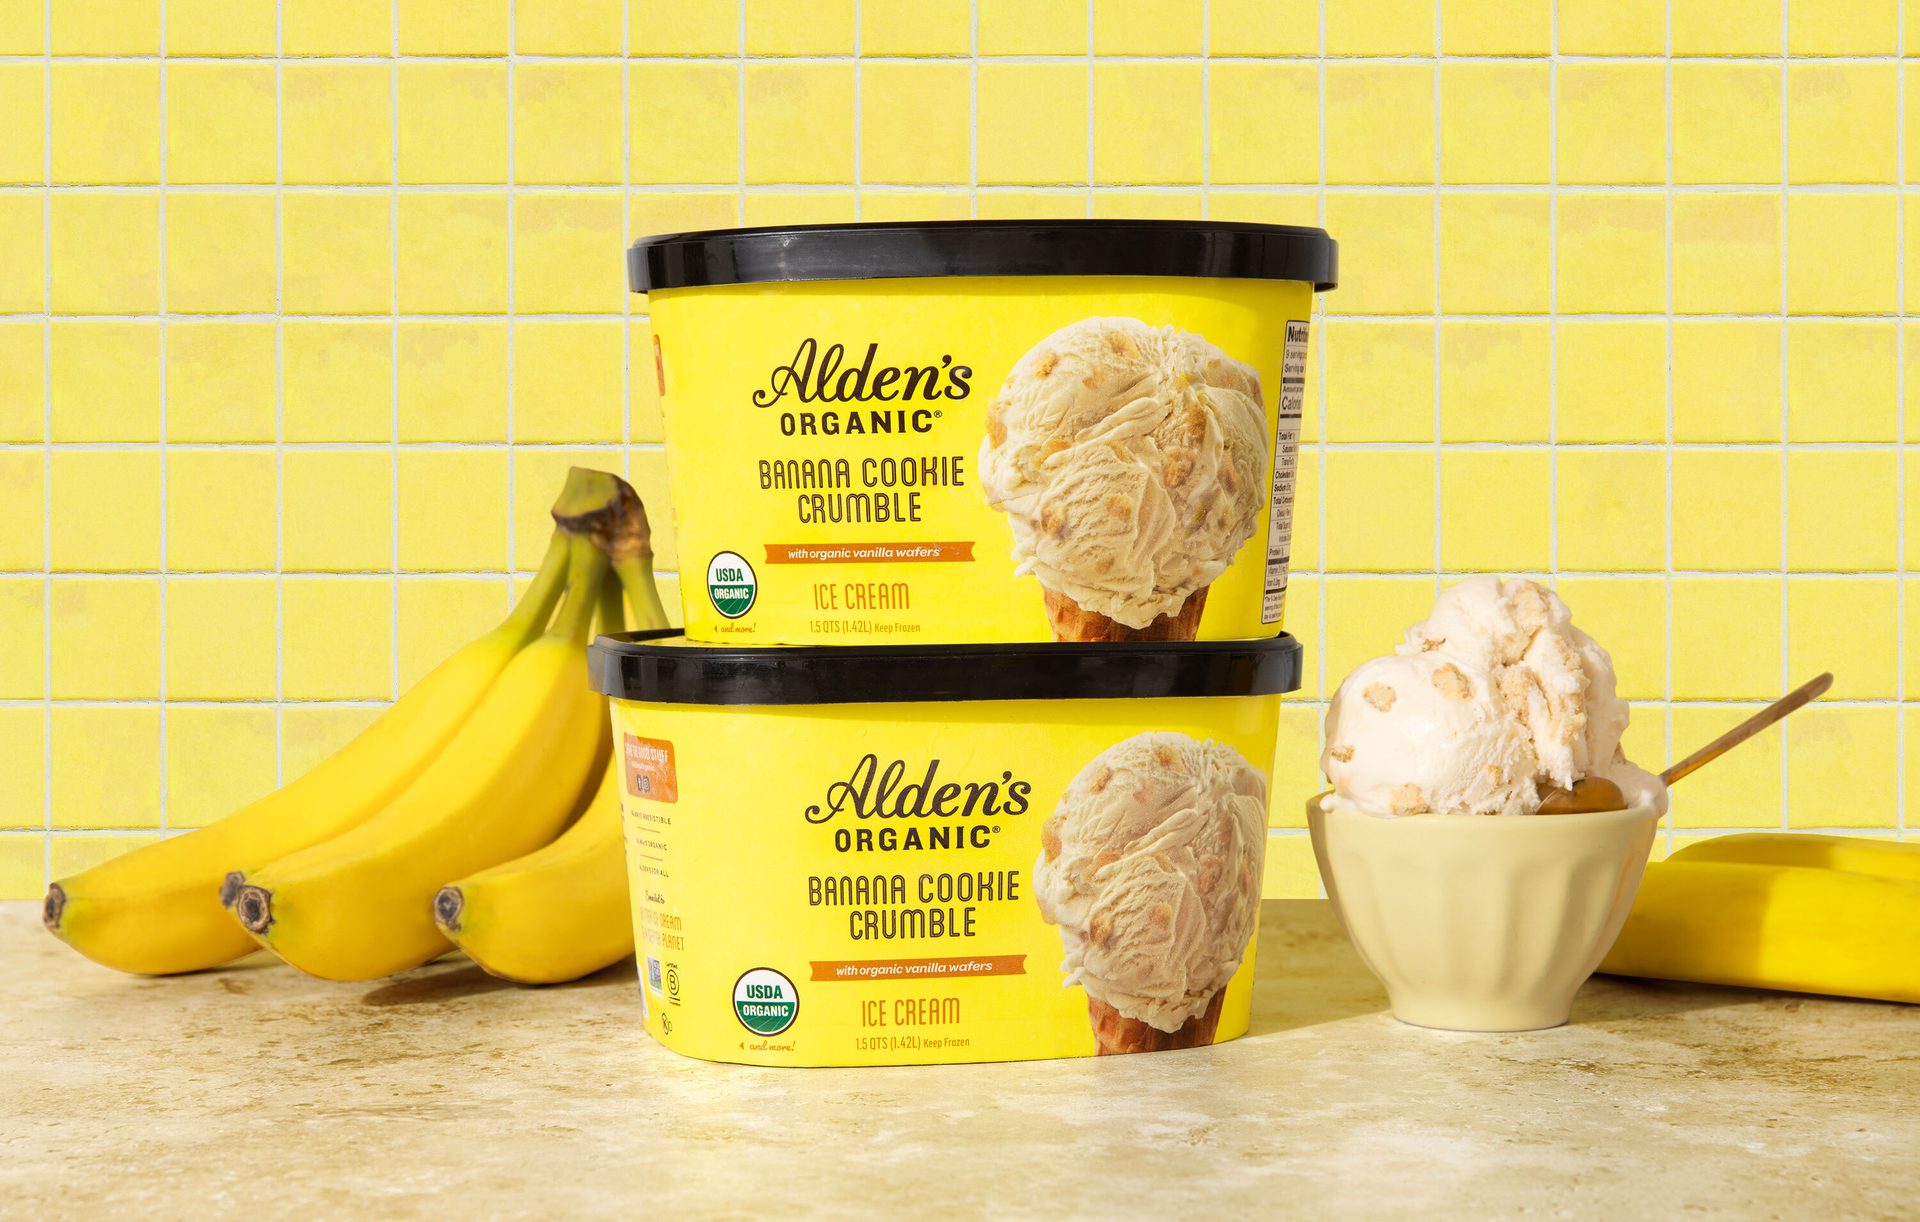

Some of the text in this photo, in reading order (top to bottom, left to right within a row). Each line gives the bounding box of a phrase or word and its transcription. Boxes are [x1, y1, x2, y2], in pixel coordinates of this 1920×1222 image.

[752, 337, 973, 409] Alden's
[758, 456, 965, 490] BANANA COOKIE
[797, 491, 922, 524] CRUMBLE
[788, 545, 941, 561] with organic vanilla wafers
[715, 567, 744, 582] USDA
[713, 587, 749, 600] ORGANIC
[813, 582, 910, 611] ICE CREAM
[720, 622, 756, 634] and more!
[809, 620, 921, 634] 1.5 QTS (1.42L) Keep Frozen
[804, 753, 1032, 824] Alden's
[808, 870, 1020, 906] BANANA COOKIE
[849, 907, 976, 940] CRUMBLE
[662, 932, 684, 951] PLANET
[836, 960, 993, 977] with organic vanilla wafers
[746, 984, 784, 1000] USDA
[742, 1004, 789, 1018] ORGANIC
[861, 997, 961, 1027] ICE CREAM
[749, 1039, 796, 1052] and more!
[855, 1035, 970, 1051] 1.5 QTS (1.42L) Keep Frozen
